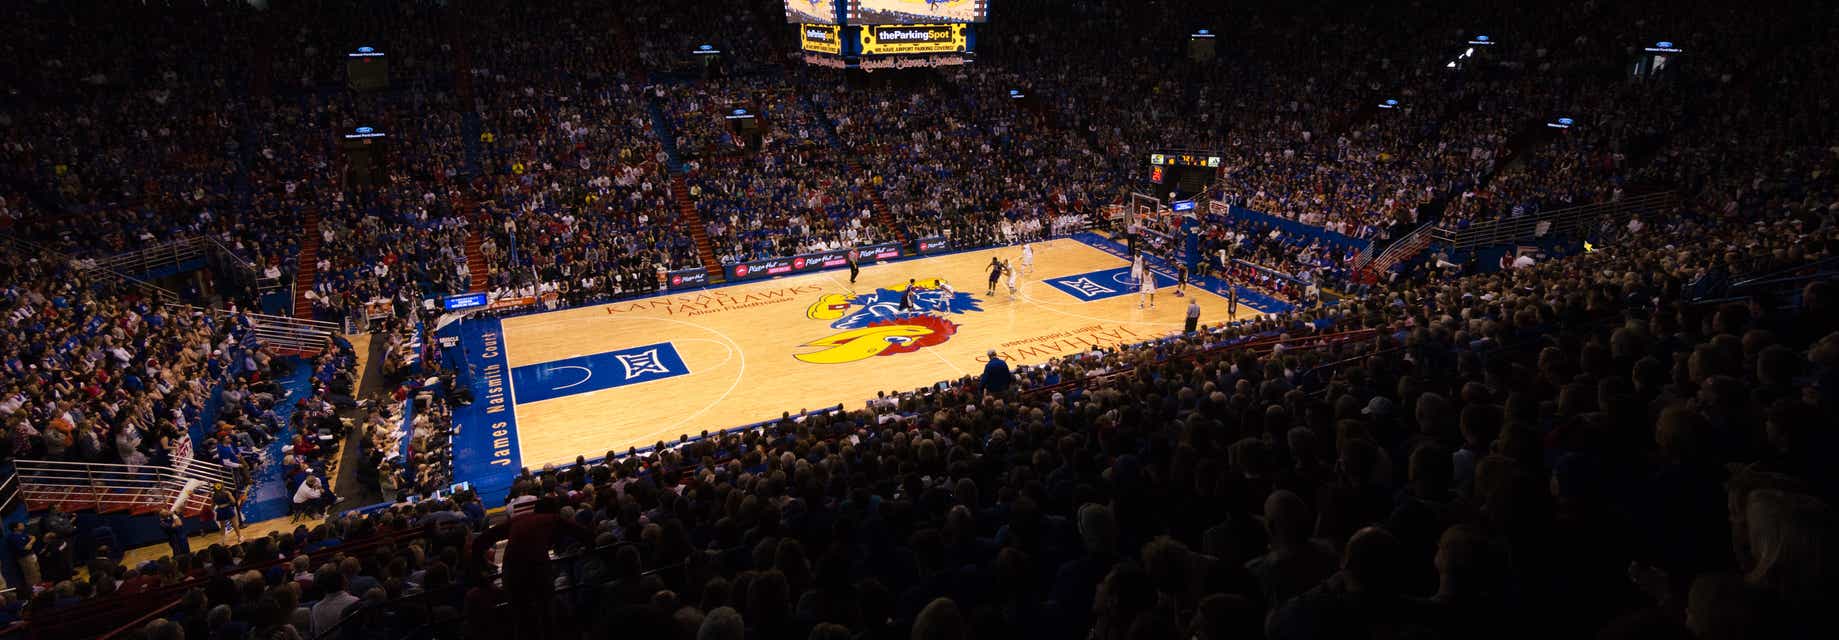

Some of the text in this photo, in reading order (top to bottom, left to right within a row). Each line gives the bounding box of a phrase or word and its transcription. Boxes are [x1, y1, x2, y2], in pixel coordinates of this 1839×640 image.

[879, 29, 951, 41] theParkingSpot
[806, 257, 822, 267] Pizza
[822, 254, 834, 263] Hut
[860, 249, 874, 259] Pizza
[875, 247, 886, 255] Hut
[748, 264, 765, 274] Pizza
[765, 260, 778, 269] Hut
[607, 290, 728, 314] KANSAS
[666, 284, 822, 315] JAYHAWKS
[688, 297, 795, 317] Allen Fieldhouse
[481, 331, 512, 466] James Naismith Court
